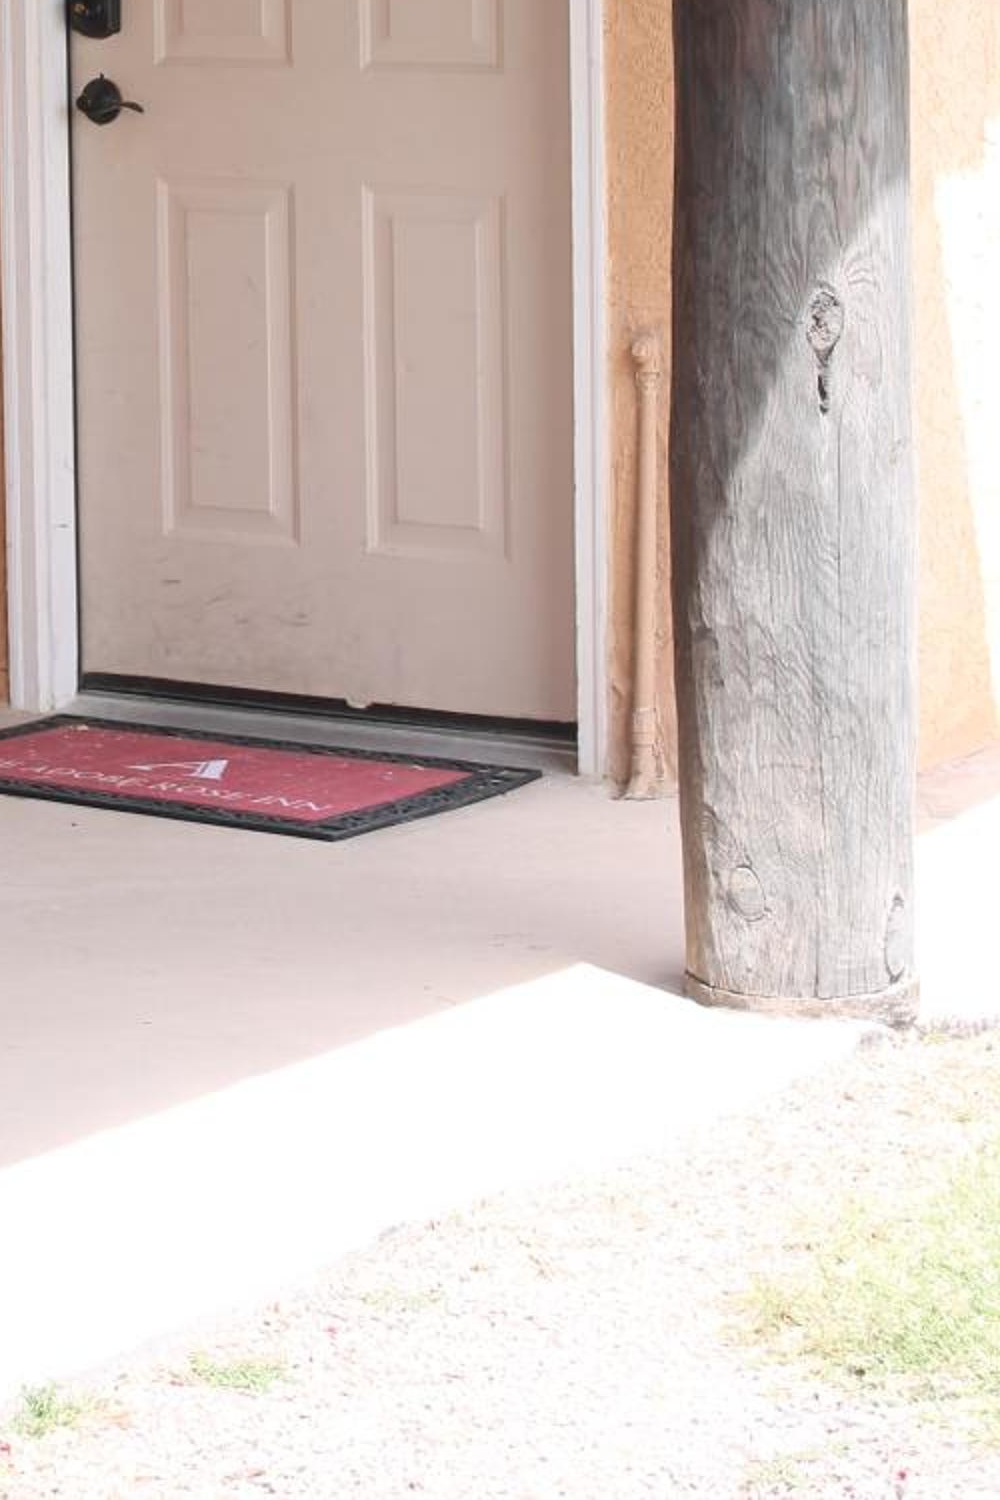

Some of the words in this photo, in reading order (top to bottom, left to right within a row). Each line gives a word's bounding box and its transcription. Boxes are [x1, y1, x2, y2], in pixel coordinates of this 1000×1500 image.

[127, 758, 229, 780] A
[148, 780, 246, 800] ROSE
[250, 795, 335, 811] INN
